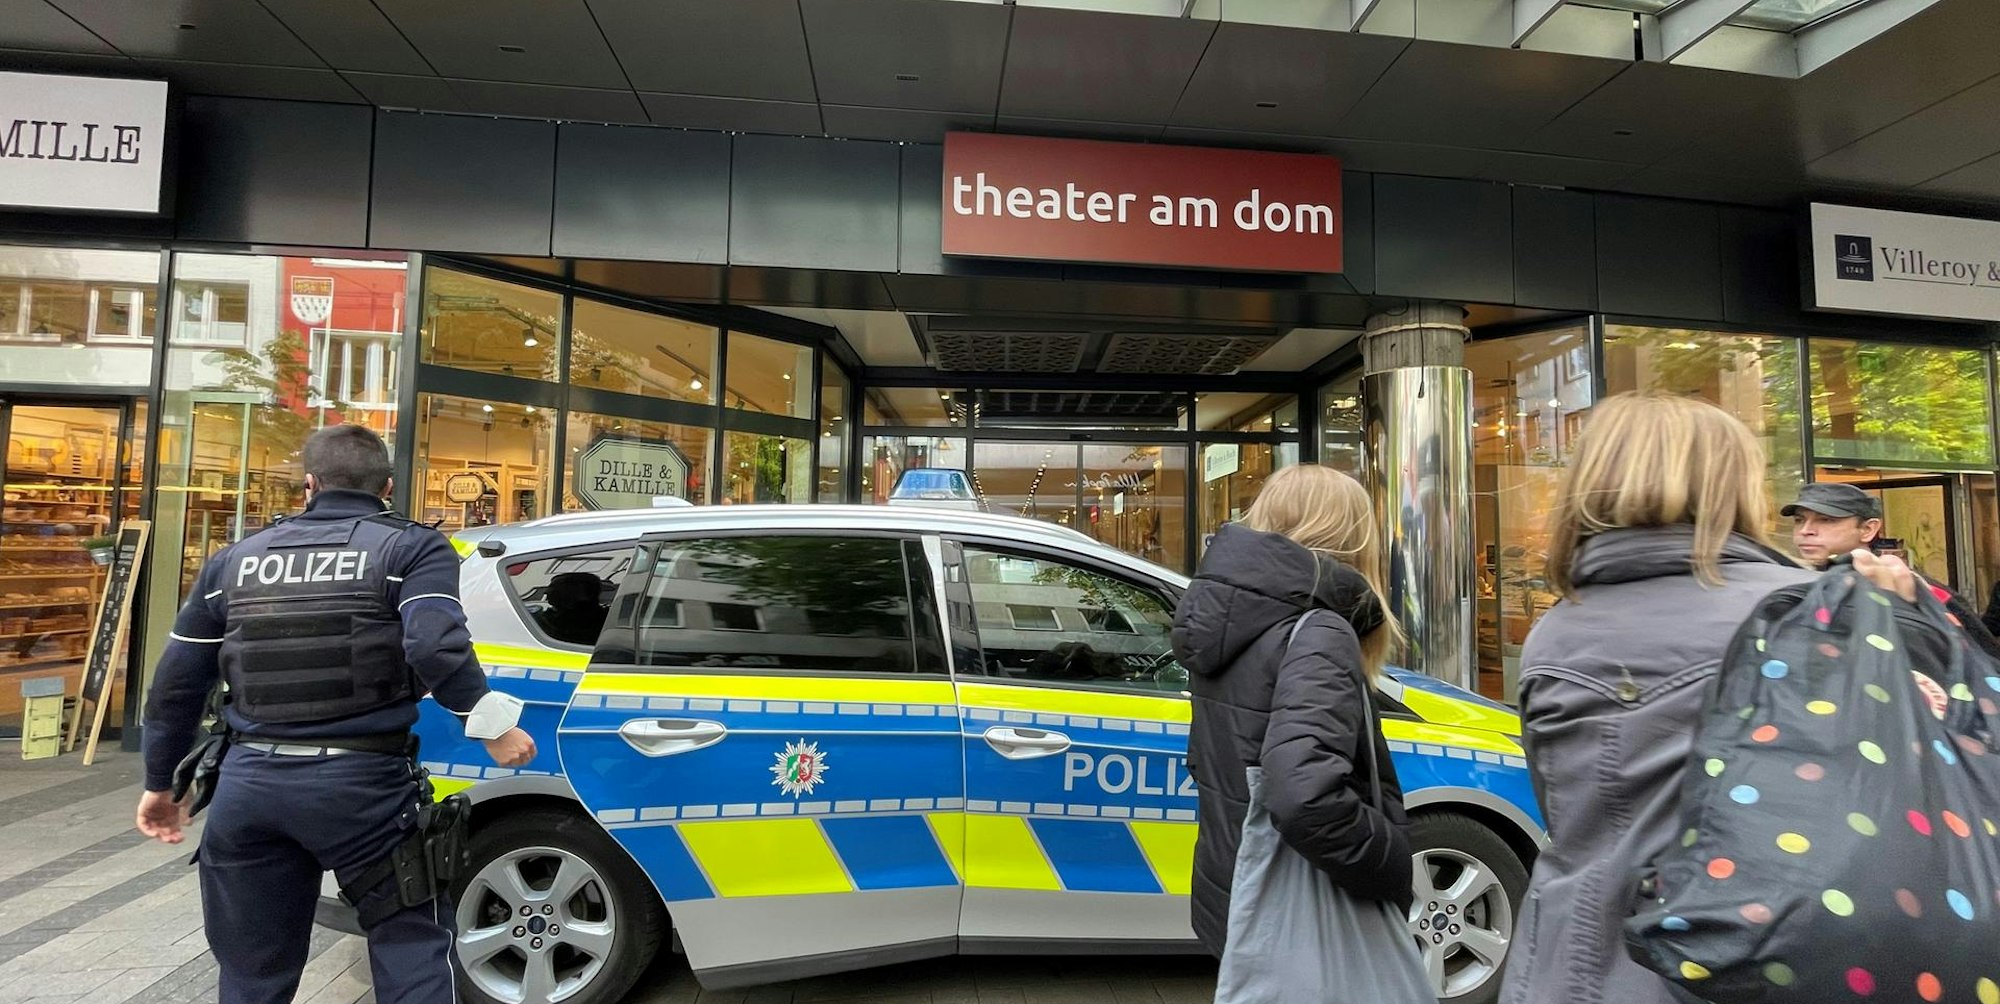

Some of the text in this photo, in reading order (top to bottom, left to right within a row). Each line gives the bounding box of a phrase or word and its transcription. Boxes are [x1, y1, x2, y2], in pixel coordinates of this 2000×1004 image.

[952, 172, 1334, 235] theater am dom
[1879, 247, 2000, 286] Villeroy &
[593, 476, 676, 496] KAMILLE
[599, 459, 673, 480] DILLE &
[236, 550, 368, 587] POLIZEI
